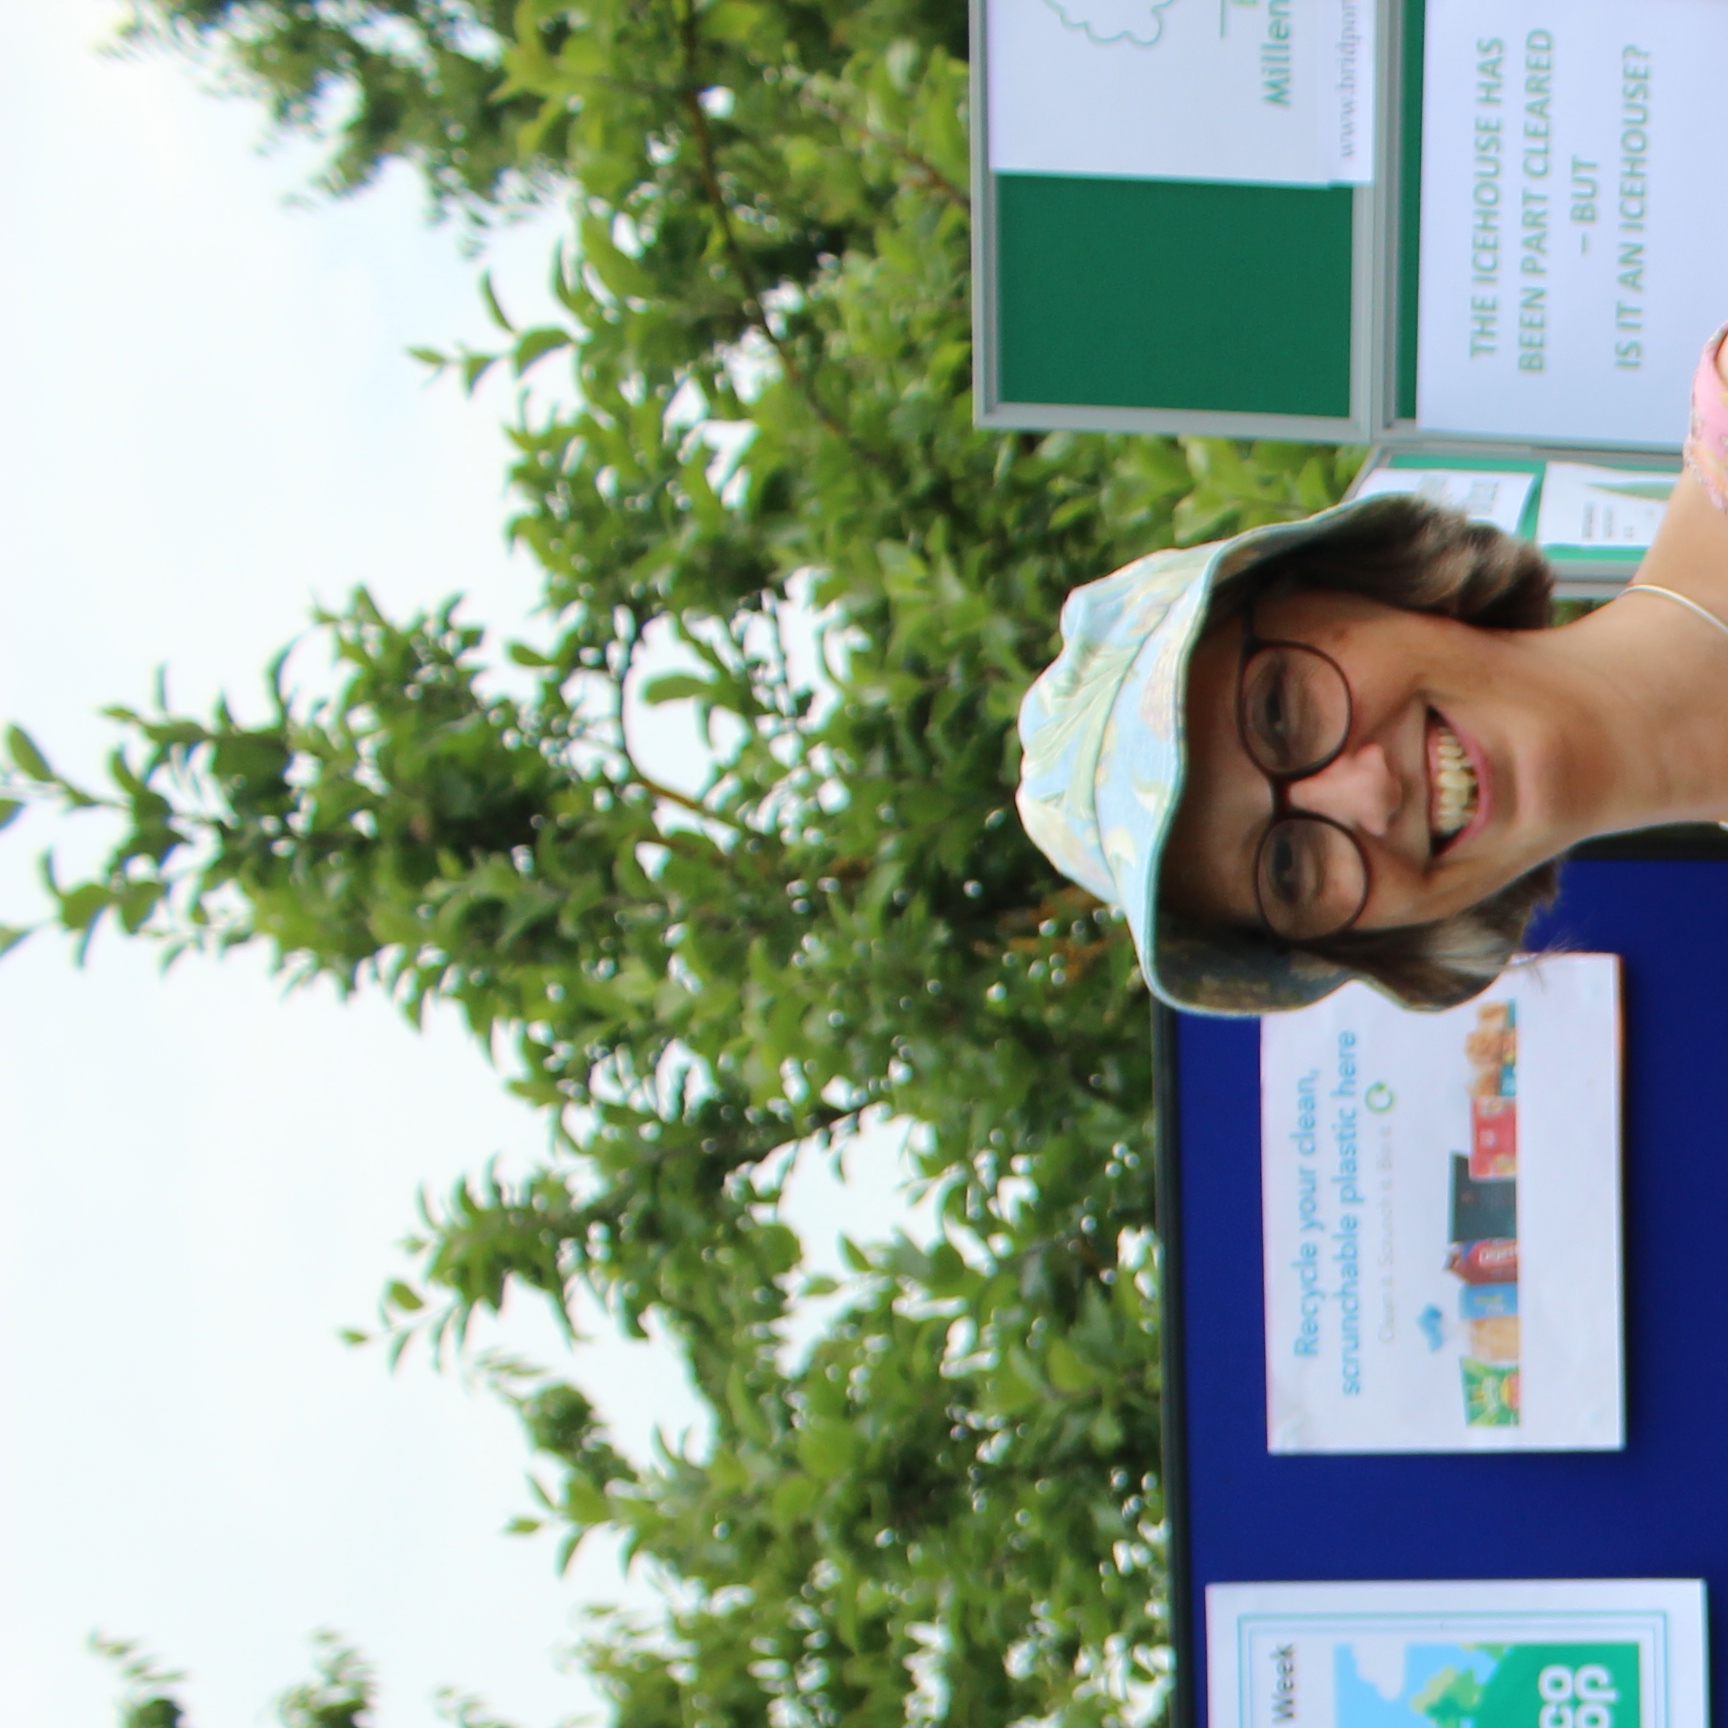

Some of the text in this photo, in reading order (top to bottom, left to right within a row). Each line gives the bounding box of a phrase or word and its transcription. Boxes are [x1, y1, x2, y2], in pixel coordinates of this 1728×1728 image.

[1468, 36, 1504, 359] THE ICEHOUSE HAS
[1516, 27, 1553, 373] BEEN PART CLEARED
[1569, 155, 1599, 224] BUT
[1614, 43, 1652, 371] IS IT AN ICEHOUSE?
[1289, 1069, 1326, 1357] Recycle your clean,
[1328, 1029, 1366, 1397] scrunchable plastic here
[1269, 1643, 1297, 1723] Week
